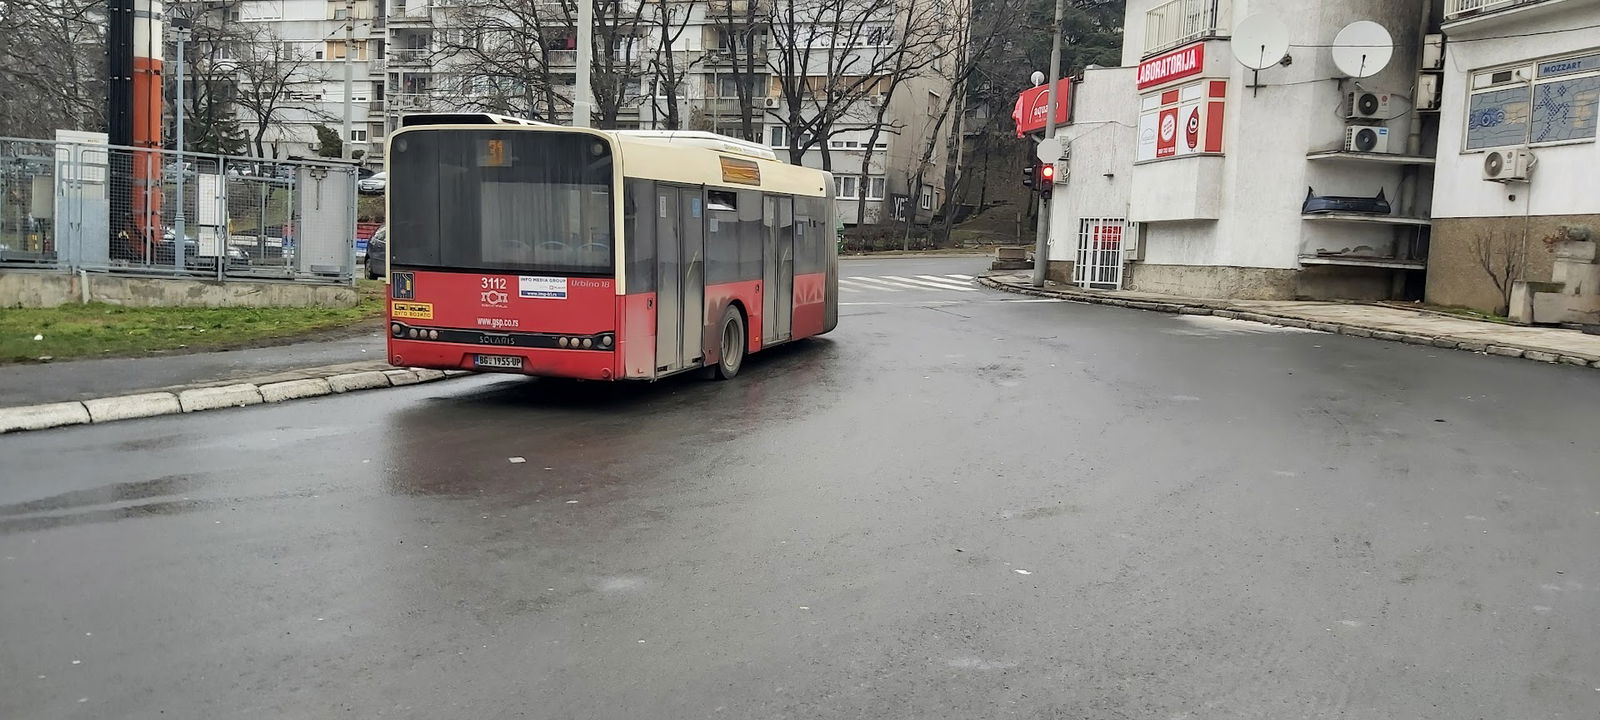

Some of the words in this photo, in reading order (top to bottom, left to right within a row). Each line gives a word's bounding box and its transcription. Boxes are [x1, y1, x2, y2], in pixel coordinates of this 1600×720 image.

[1136, 49, 1196, 84] LABORATORIJA
[1543, 61, 1582, 73] MOZZART
[481, 277, 507, 289] 3112
[571, 280, 600, 288] Urbino
[477, 317, 519, 328] www.gsp.co.rs
[479, 335, 515, 345] SOLARIS
[479, 356, 489, 365] BG
